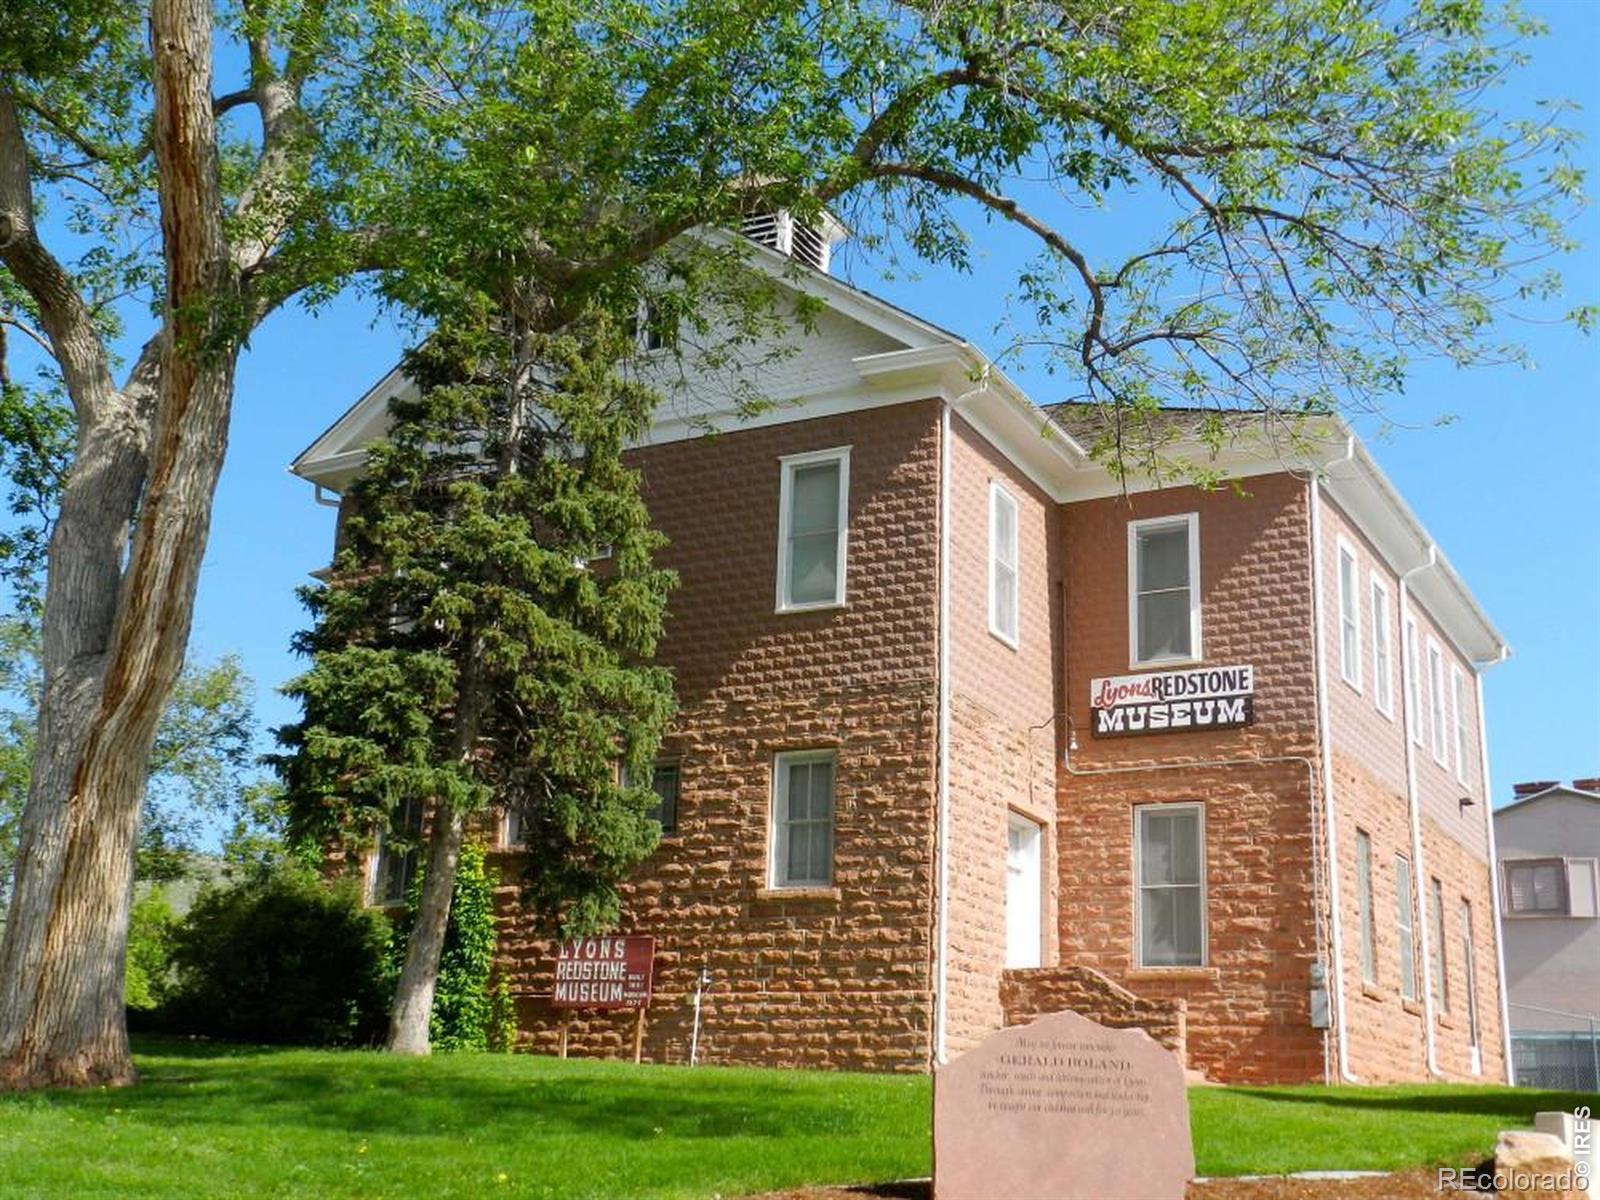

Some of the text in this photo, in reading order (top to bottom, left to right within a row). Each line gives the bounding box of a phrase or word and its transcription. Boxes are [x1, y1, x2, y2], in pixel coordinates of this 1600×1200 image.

[1094, 669, 1249, 707] Lyons REDSTONE
[1098, 698, 1246, 732] MUSEUM
[560, 939, 625, 959] LYONS
[556, 961, 627, 980] REDSTONE
[555, 981, 624, 1002] MUSEUM
